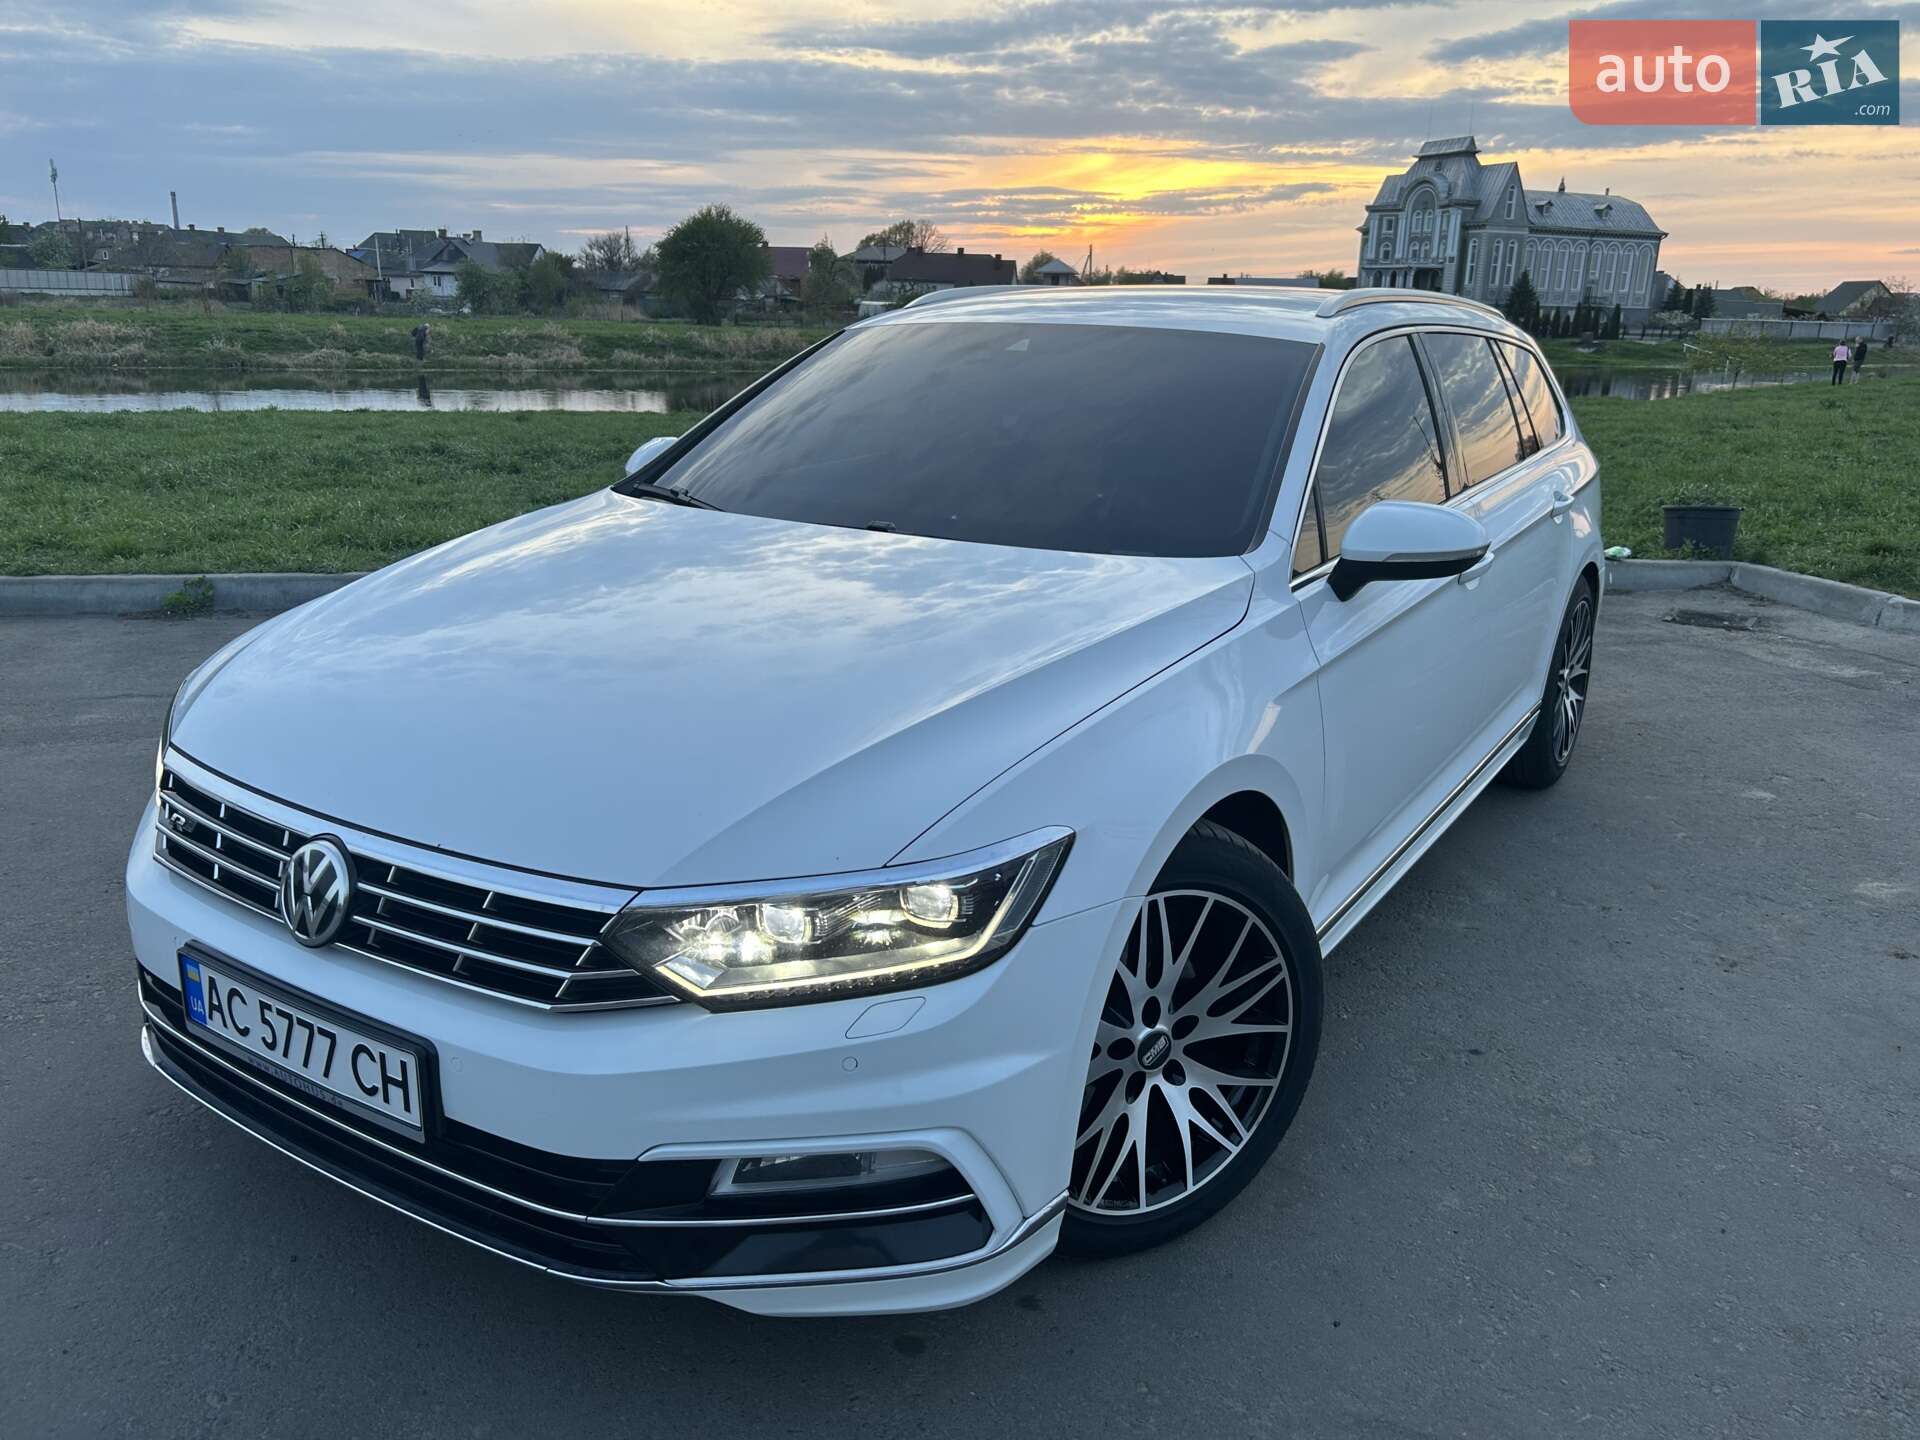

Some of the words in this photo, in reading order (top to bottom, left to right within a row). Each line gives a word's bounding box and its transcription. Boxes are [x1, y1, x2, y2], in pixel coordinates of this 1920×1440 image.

[190, 995, 204, 1015] UA
[208, 975, 250, 1037] AC
[259, 1000, 337, 1079] 5777
[351, 1044, 411, 1113] CH
